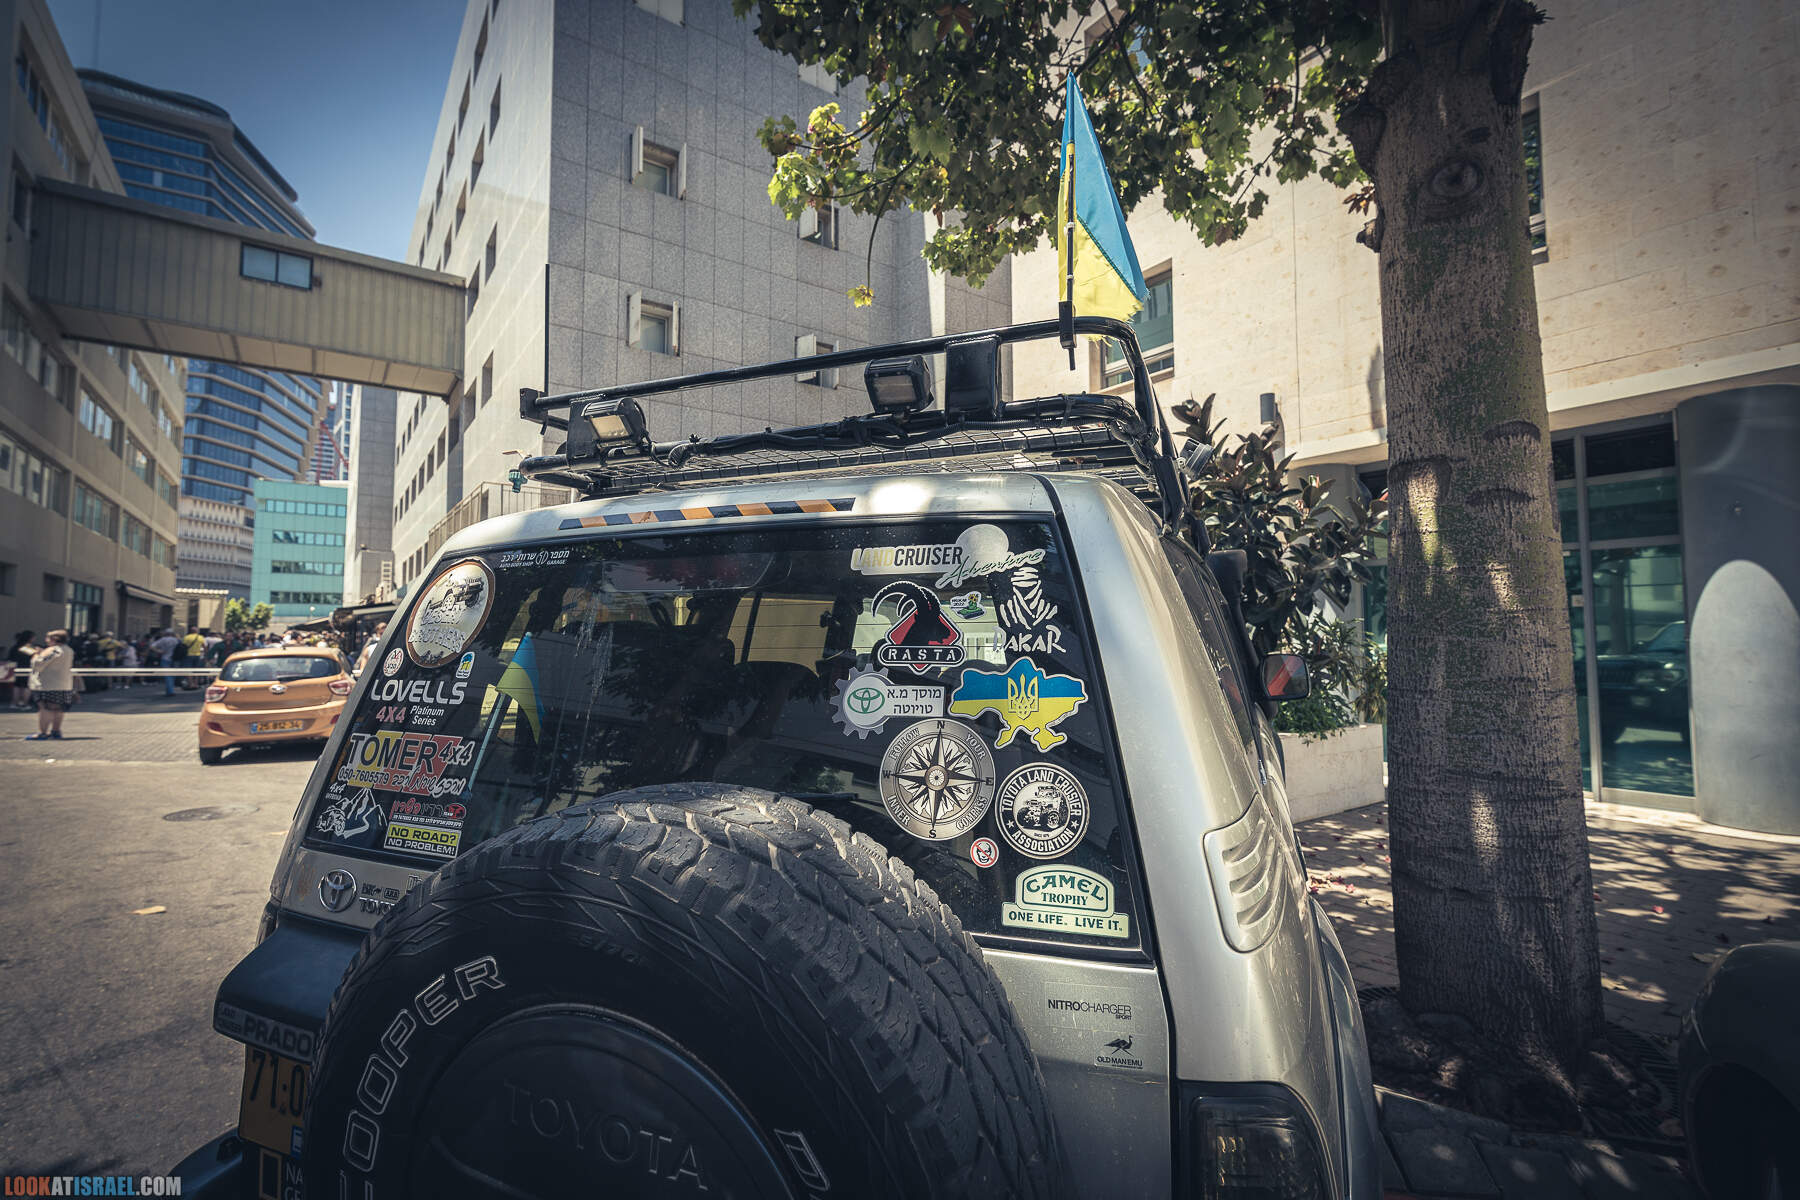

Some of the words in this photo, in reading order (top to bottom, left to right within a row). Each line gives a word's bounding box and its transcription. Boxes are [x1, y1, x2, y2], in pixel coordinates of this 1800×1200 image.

[991, 624, 1067, 654] DAKAR
[888, 648, 957, 662] RASTA
[370, 679, 468, 705] LOVELLS
[911, 688, 942, 702] מוסך
[410, 705, 445, 717] Platinum
[893, 704, 934, 715] טויוטה
[412, 715, 437, 726] Series
[936, 719, 946, 729] N
[889, 727, 920, 760] FOLLOW
[965, 733, 987, 760] YOUR
[348, 734, 438, 774] TOMER
[339, 767, 390, 785] 050-7605579
[1002, 776, 1028, 812] TOYOTA
[1027, 769, 1055, 783] LAND
[887, 794, 911, 826] INNER
[956, 796, 988, 831] COMPASS
[390, 826, 410, 838] NO
[412, 829, 457, 846] ROAD?
[928, 828, 937, 839] S
[1012, 827, 1075, 853] ASSOCIATION
[388, 837, 403, 848] NO
[404, 839, 455, 855] PROBLEM!
[1026, 874, 1105, 901] CAMEL
[1041, 892, 1089, 906] TROPHY
[1008, 910, 1034, 922] ONE
[1037, 913, 1068, 926] LIFE.
[1075, 916, 1104, 929] LIVE
[1108, 919, 1123, 932] IT.
[1047, 999, 1133, 1016] NITROCHARGER
[244, 1014, 312, 1057] PRADO
[1096, 1056, 1111, 1064] OLD
[1111, 1057, 1127, 1065] MAN
[1127, 1059, 1143, 1067] EMU
[338, 955, 506, 1200] OOPER
[503, 1077, 709, 1191] TOYOTA
